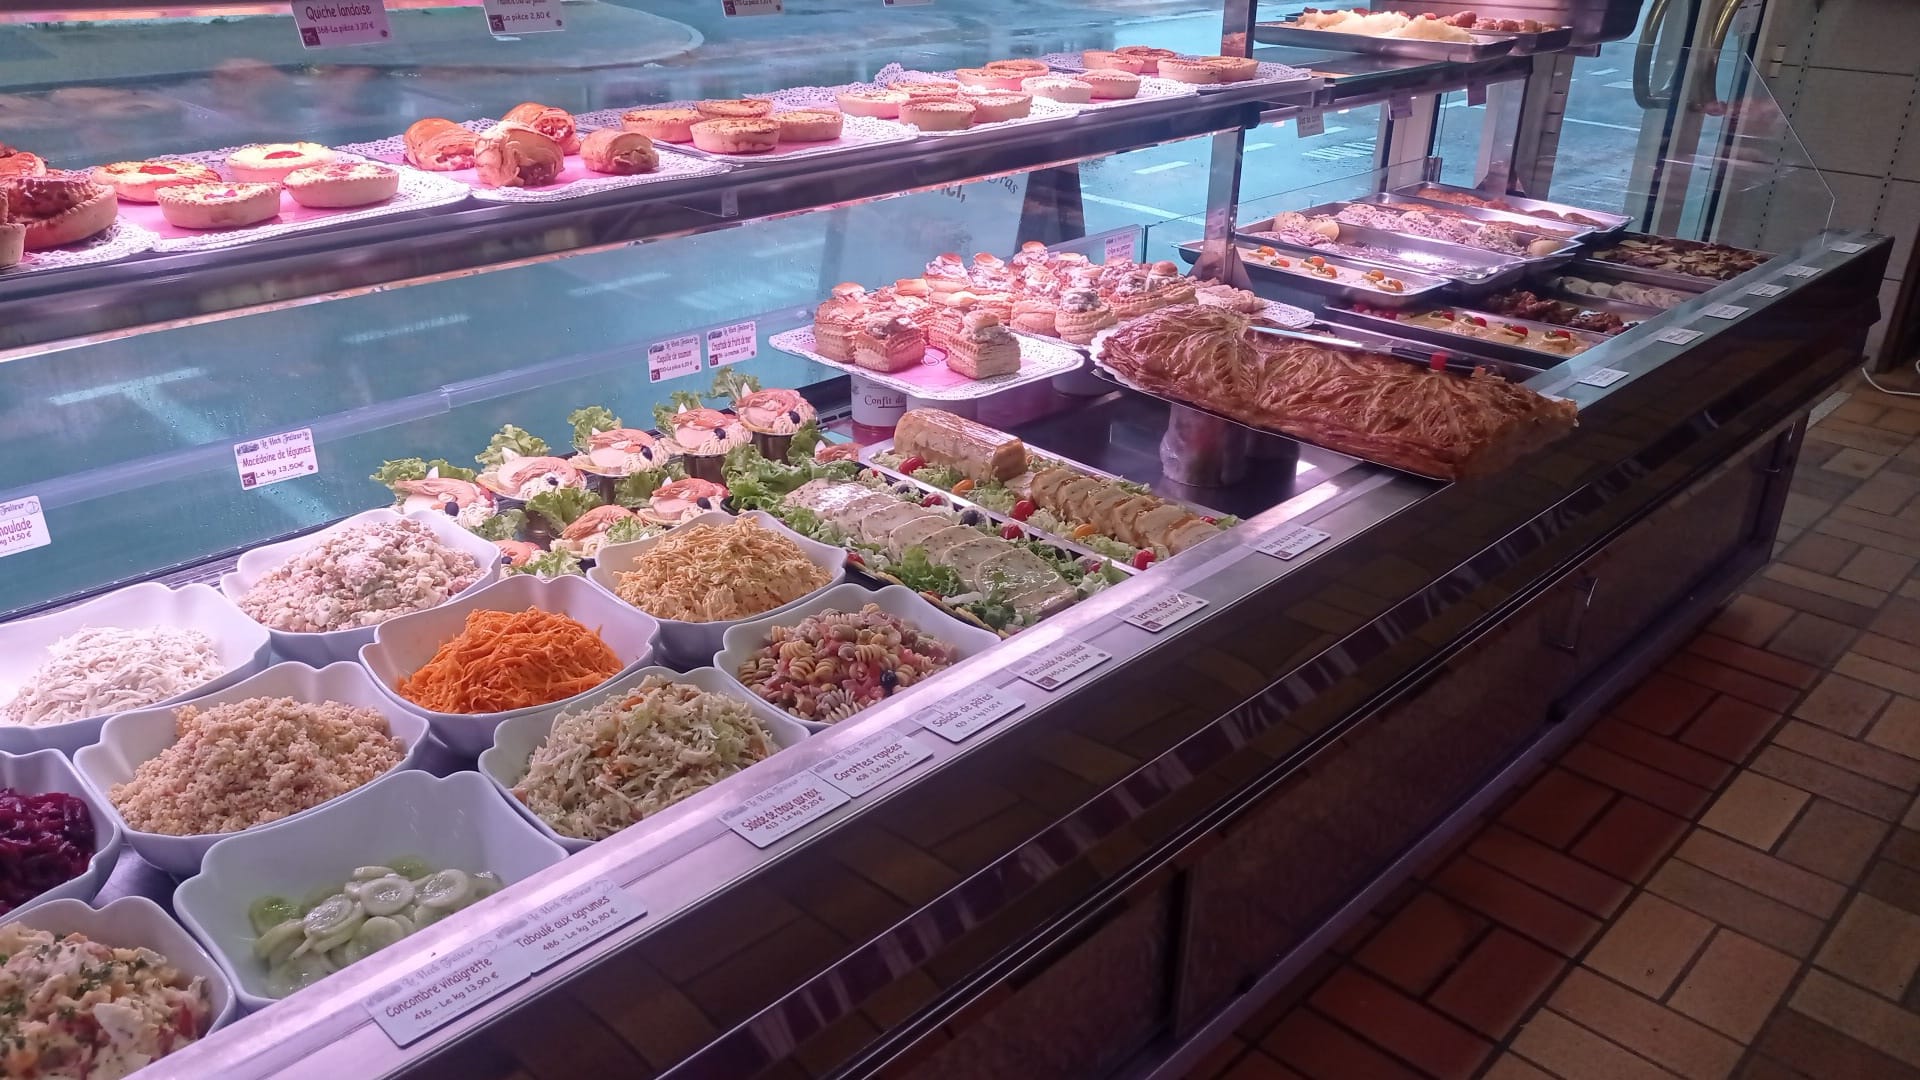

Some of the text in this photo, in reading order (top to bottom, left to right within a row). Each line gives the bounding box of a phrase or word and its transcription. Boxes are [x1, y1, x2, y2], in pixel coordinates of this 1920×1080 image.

[305, 3, 371, 22] Quiche landaise
[864, 394, 892, 408] Confit
[242, 445, 311, 467] Macédoine de légumes
[26, 530, 32, 538] €
[1129, 606, 1162, 620] Terrine
[932, 711, 962, 727] Salade
[959, 704, 973, 713] de
[970, 692, 994, 709] pâtes
[833, 757, 875, 781] Carottes
[872, 743, 903, 763] rapées
[741, 815, 770, 831] Salade
[765, 810, 779, 821] de
[513, 922, 555, 949] Taboulé
[554, 913, 574, 930] aux
[572, 895, 612, 920] agrumes
[565, 930, 578, 941] Le
[575, 924, 590, 936] kg
[385, 984, 442, 1019] Concombre
[439, 957, 494, 990] vinaigrette
[414, 1008, 433, 1021] 416
[439, 997, 454, 1008] Le
[451, 989, 467, 1002] kg
[464, 975, 492, 994] 13,90
[490, 970, 500, 980] €
